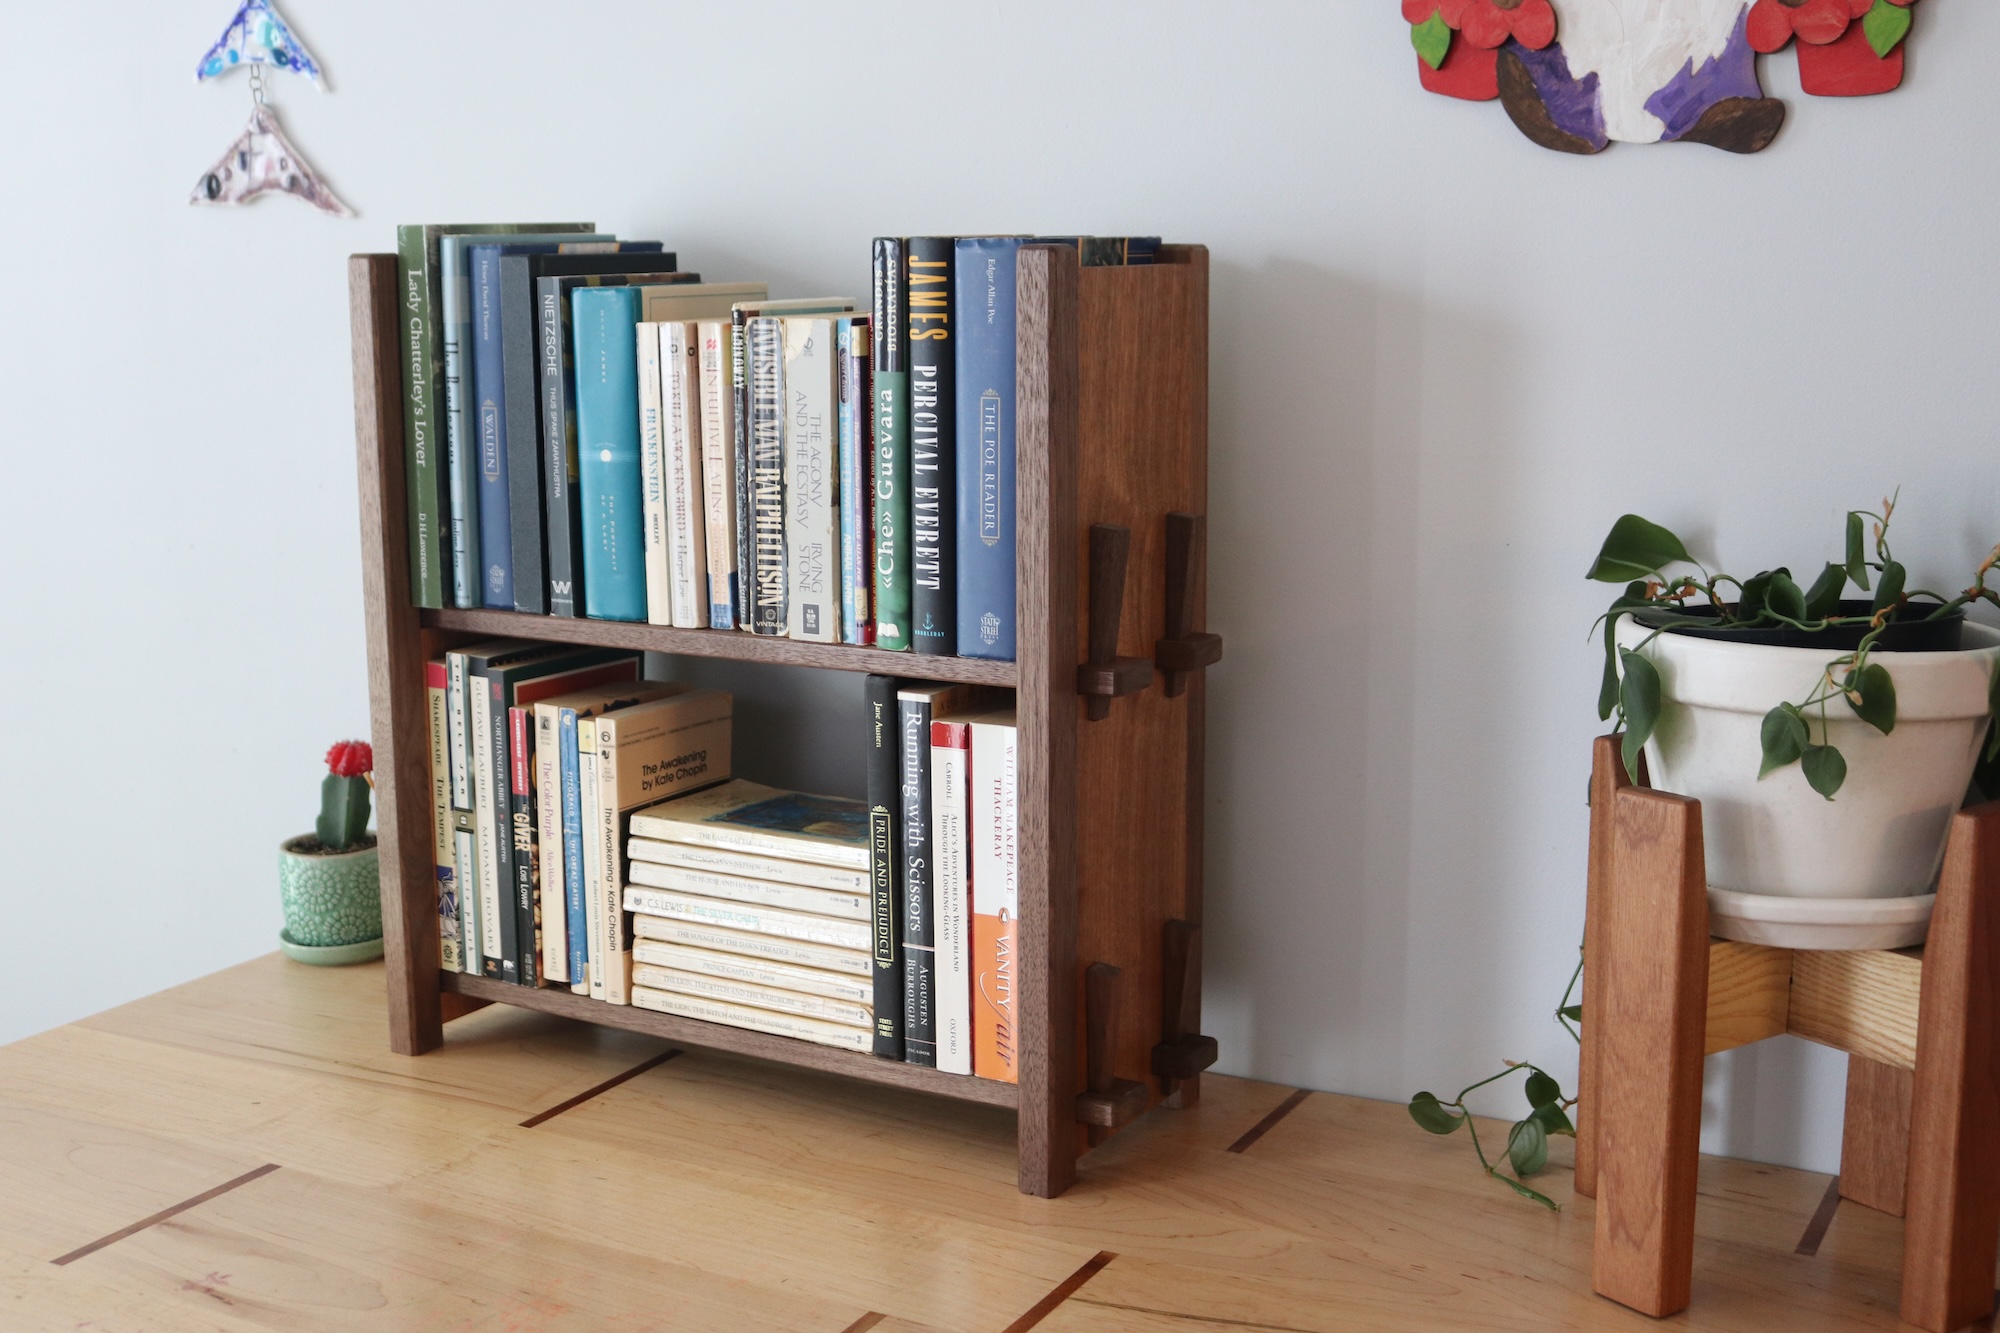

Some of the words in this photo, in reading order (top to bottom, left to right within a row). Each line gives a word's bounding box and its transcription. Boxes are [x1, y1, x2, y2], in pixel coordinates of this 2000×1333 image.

[407, 269, 422, 312] Lady
[481, 260, 489, 285] Henry
[986, 259, 996, 284] Edgar
[482, 286, 490, 308] David
[875, 270, 884, 342] GRANDES
[885, 260, 898, 352] BIOGRAFÍAS
[908, 255, 949, 342] JAMES
[987, 285, 996, 307] Allan
[544, 294, 557, 376] NIETZSCHE
[988, 308, 996, 325] Poe
[410, 317, 427, 415] Chatterley's
[444, 340, 460, 367] The
[732, 325, 745, 390] HEMINGWAY
[754, 323, 777, 414] INVISIBLE
[671, 371, 681, 389] TO
[551, 410, 559, 437] SPAKE
[672, 393, 682, 423] KILL
[706, 368, 720, 450] INTUITIVE
[796, 391, 808, 427] AND
[810, 413, 822, 442] THE
[913, 364, 939, 476] PERCIVAL
[984, 404, 996, 432] THE
[414, 421, 427, 467] Lover
[486, 414, 496, 468] WALDEN
[646, 408, 661, 502] FRANKENSTEIN
[755, 418, 780, 462] MAN
[797, 431, 808, 459] THE
[878, 389, 895, 500] Guevara
[984, 440, 996, 467] POE
[552, 440, 562, 499] ZARATHUSTRA
[674, 440, 687, 531] MOCKINGBIRD
[709, 457, 724, 521] EATING
[810, 447, 822, 508] AGONY
[419, 513, 427, 521] D
[756, 468, 781, 529] RALPH
[796, 465, 809, 529] ECSTASY
[984, 473, 997, 531] READER
[419, 523, 428, 533] H
[914, 486, 941, 591] EVERETT
[420, 534, 429, 579] Lawrence
[677, 545, 688, 578] Harper
[756, 532, 783, 607] ELLISON
[799, 545, 811, 592] STONE
[811, 543, 823, 593] IRVING
[844, 534, 853, 571] ANIMAL
[679, 579, 688, 598] Lee
[845, 576, 853, 605] FARM
[756, 620, 784, 628] VINTAGE
[433, 694, 442, 767] SHAKESPEARE
[475, 682, 485, 743] GUSTAVE
[872, 702, 882, 720] Jane
[494, 715, 504, 779] NORTHANGER
[515, 719, 523, 759] LAUREL-LEAF
[875, 721, 883, 748] Austen
[543, 761, 553, 779] The
[642, 765, 658, 776] The
[659, 750, 708, 773] Awakening
[902, 711, 924, 799] Running
[436, 777, 445, 800] THE
[478, 745, 488, 812] FLAUBERT
[498, 783, 506, 809] ABBEY
[544, 781, 553, 808] Color
[567, 771, 575, 817] FITZGERALD
[642, 779, 654, 791] by
[654, 773, 675, 787] Kate
[675, 763, 708, 780] Chopin
[945, 762, 953, 800] CARROLL
[1005, 745, 1014, 808] WILLIAM
[437, 803, 447, 851] TEMPEST
[513, 813, 531, 852] GIVER
[543, 809, 555, 840] Purple
[604, 808, 613, 825] The
[876, 819, 886, 854] PRIDE
[908, 804, 925, 848] with
[950, 814, 958, 845] ALICE'S
[993, 777, 1002, 861] THACKERAY
[482, 825, 492, 891] MADAME
[547, 849, 555, 866] Alice
[604, 827, 617, 883] Awakening
[1006, 811, 1015, 894] MAKEPEACE
[462, 854, 471, 901] sylvia
[519, 865, 529, 881] LOIS
[877, 859, 887, 887] AND
[951, 848, 959, 901] ADVENTURES
[520, 884, 530, 910] LOWRY
[572, 882, 580, 911] GATSBY
[607, 890, 616, 913] Kate
[660, 900, 684, 912] LEWIS
[693, 905, 707, 914] THE
[708, 907, 733, 918] SILVER
[735, 909, 760, 922] CHAIR
[908, 856, 926, 932] Scissors
[943, 873, 951, 940] LOOKING-GLASS
[952, 903, 958, 913] IN
[464, 911, 475, 952] plath
[486, 897, 495, 953] BOVARY
[594, 922, 602, 954] Stevenson
[608, 919, 619, 952] Chopin
[877, 892, 888, 955] PREJUDICE
[952, 915, 960, 972] WONDERLAND
[676, 929, 690, 938] THE
[690, 931, 715, 943] VOYAGE
[715, 935, 725, 944] OF
[726, 938, 738, 946] THE
[738, 941, 759, 950] DAWN
[759, 944, 790, 956] TREADER
[795, 951, 811, 960] Lewis
[703, 961, 725, 972] PRINCE
[726, 965, 755, 977] CASPIAN
[995, 934, 1010, 1011] VANITY
[906, 959, 917, 1029] BURROUGHS
[919, 965, 930, 1026] AUGUSTEN
[661, 1000, 674, 1009] THE
[692, 1006, 704, 1015] THE
[705, 1008, 727, 1019] WITCH
[728, 1013, 743, 1022] AND
[743, 1015, 757, 1024] THE
[757, 1018, 793, 1030] WARDROBE
[878, 1024, 894, 1032] STREET
[907, 1047, 931, 1056] PICADOR
